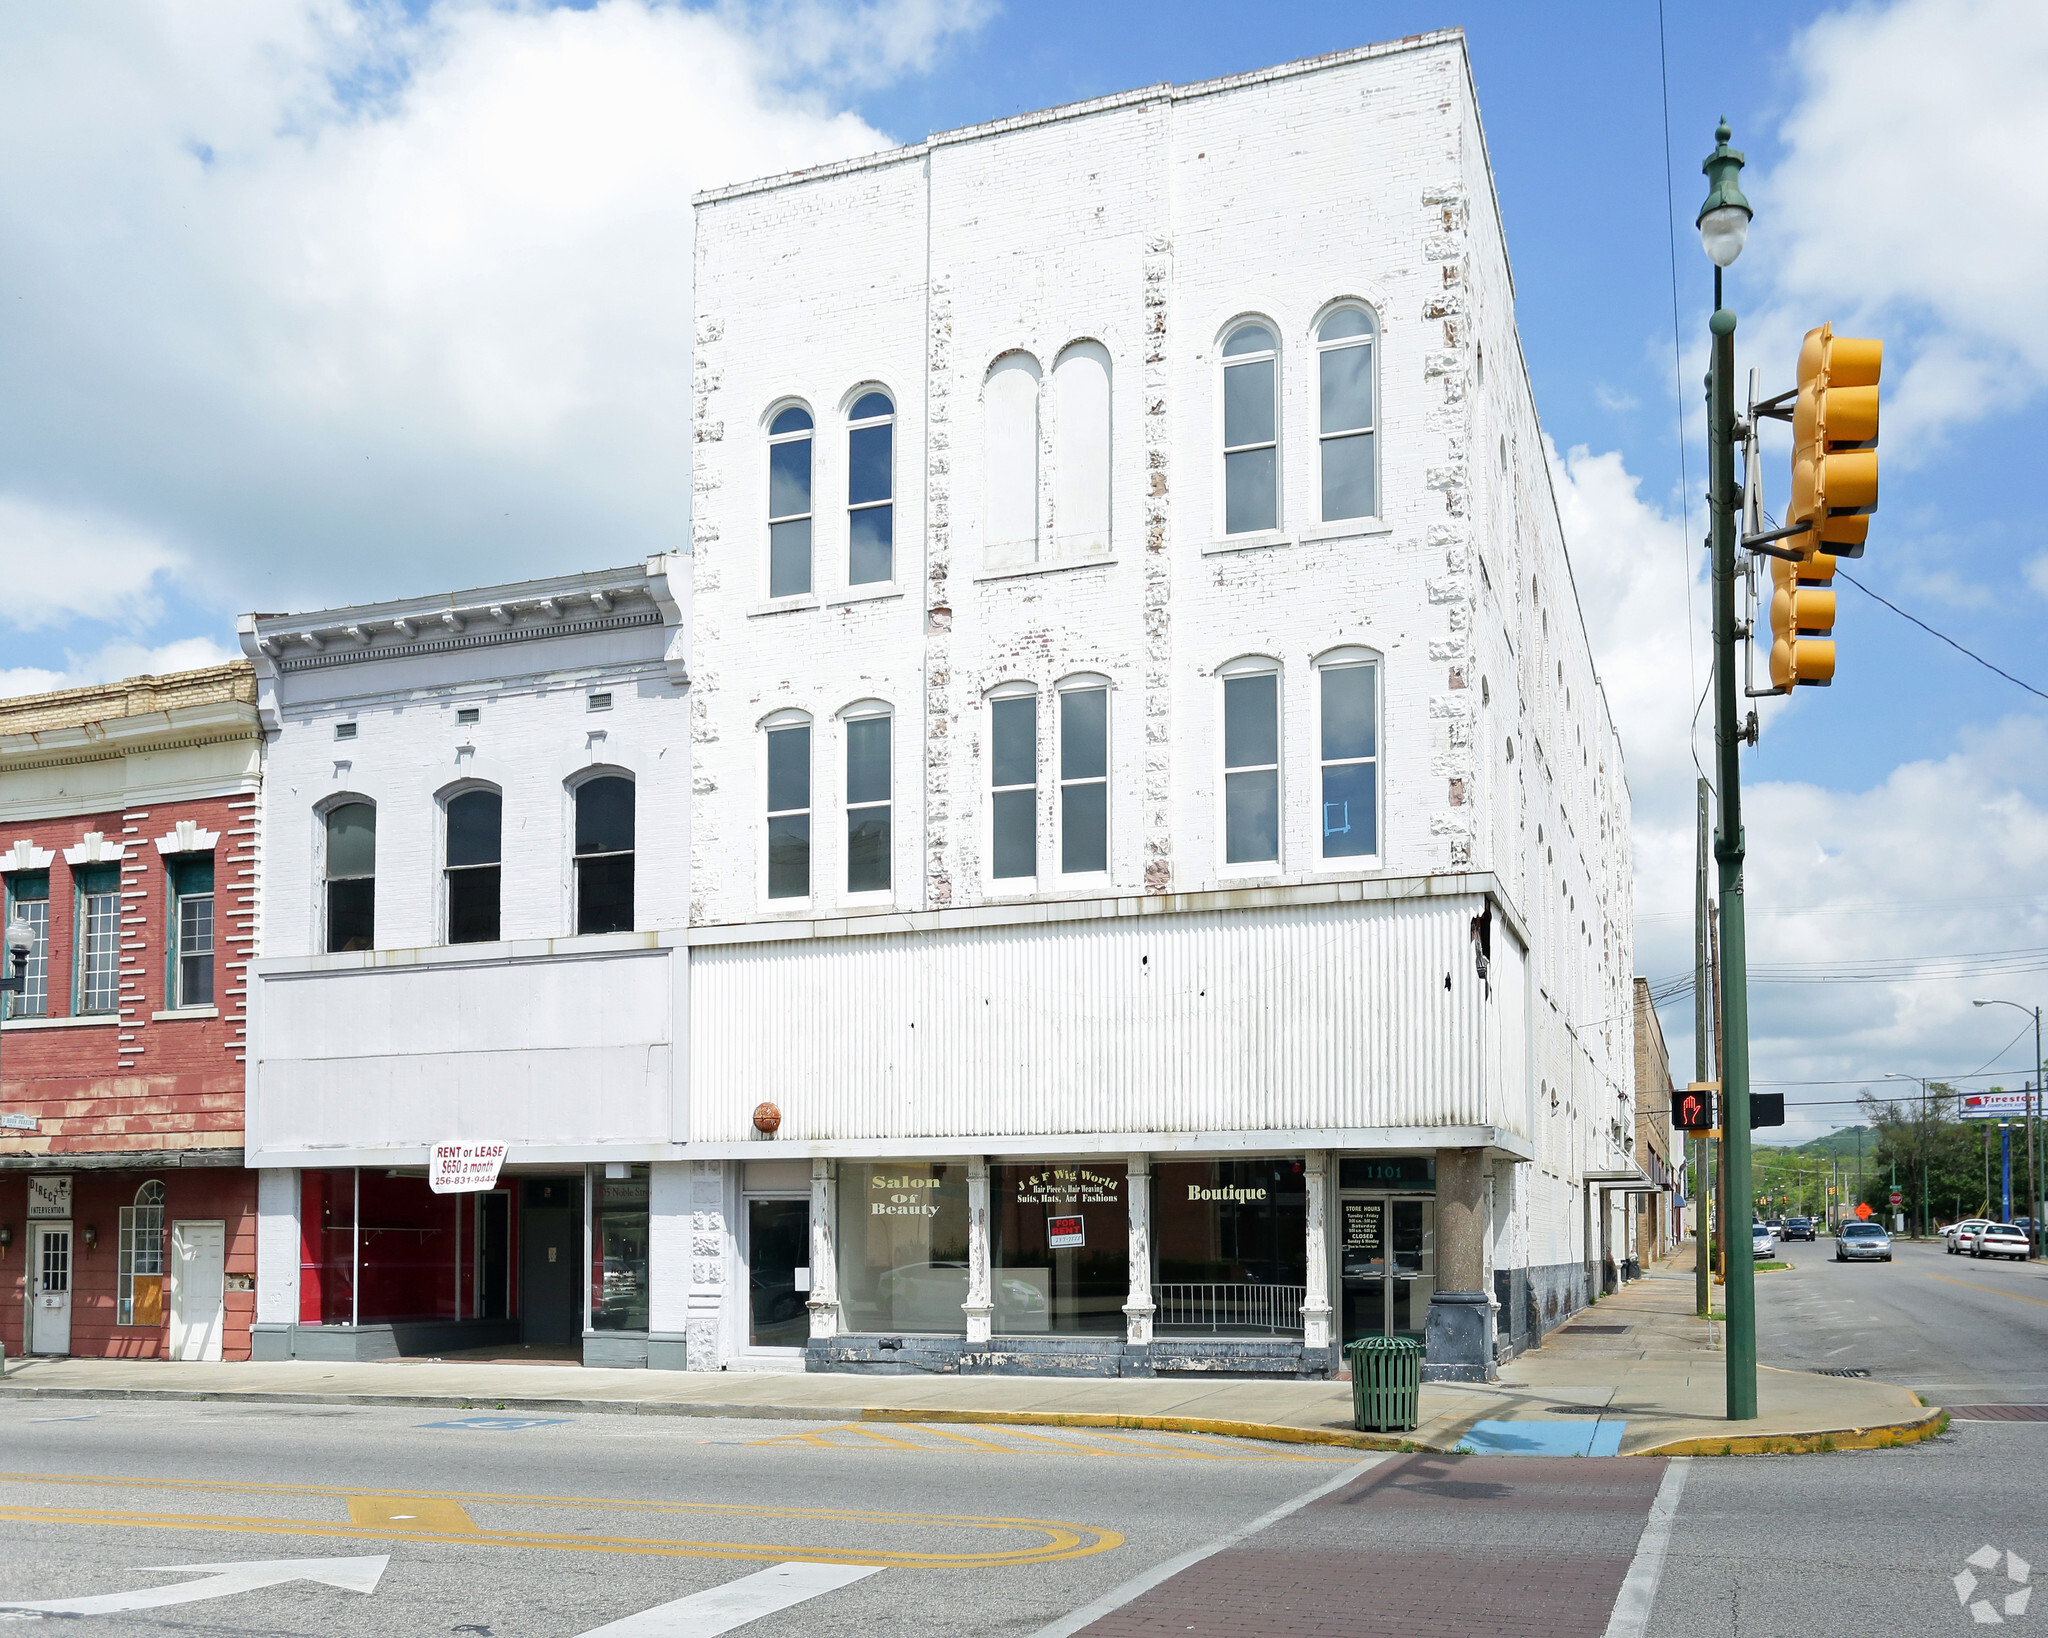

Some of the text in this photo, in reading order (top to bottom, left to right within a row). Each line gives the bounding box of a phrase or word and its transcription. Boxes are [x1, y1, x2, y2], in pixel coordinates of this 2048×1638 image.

[437, 1146, 504, 1157] RENT or LEASE
[442, 1160, 493, 1173] $650 a month
[1368, 1166, 1401, 1178] 1101
[872, 1175, 941, 1189] Salon
[1018, 1170, 1118, 1191] J & F Wig World
[30, 1179, 57, 1205] DIRECT
[613, 1187, 632, 1196] Noble
[1033, 1185, 1045, 1193] Hair
[1067, 1185, 1080, 1193] Hair
[1080, 1185, 1103, 1194] Weaving
[1187, 1184, 1267, 1204] Boutique
[890, 1194, 918, 1204] Of
[1017, 1194, 1118, 1204] Suits, Hats, And Fashions
[31, 1206, 65, 1214] INTERVENTION
[871, 1203, 940, 1217] Beauty
[1056, 1219, 1075, 1227] FOR
[1052, 1226, 1080, 1235] RENT
